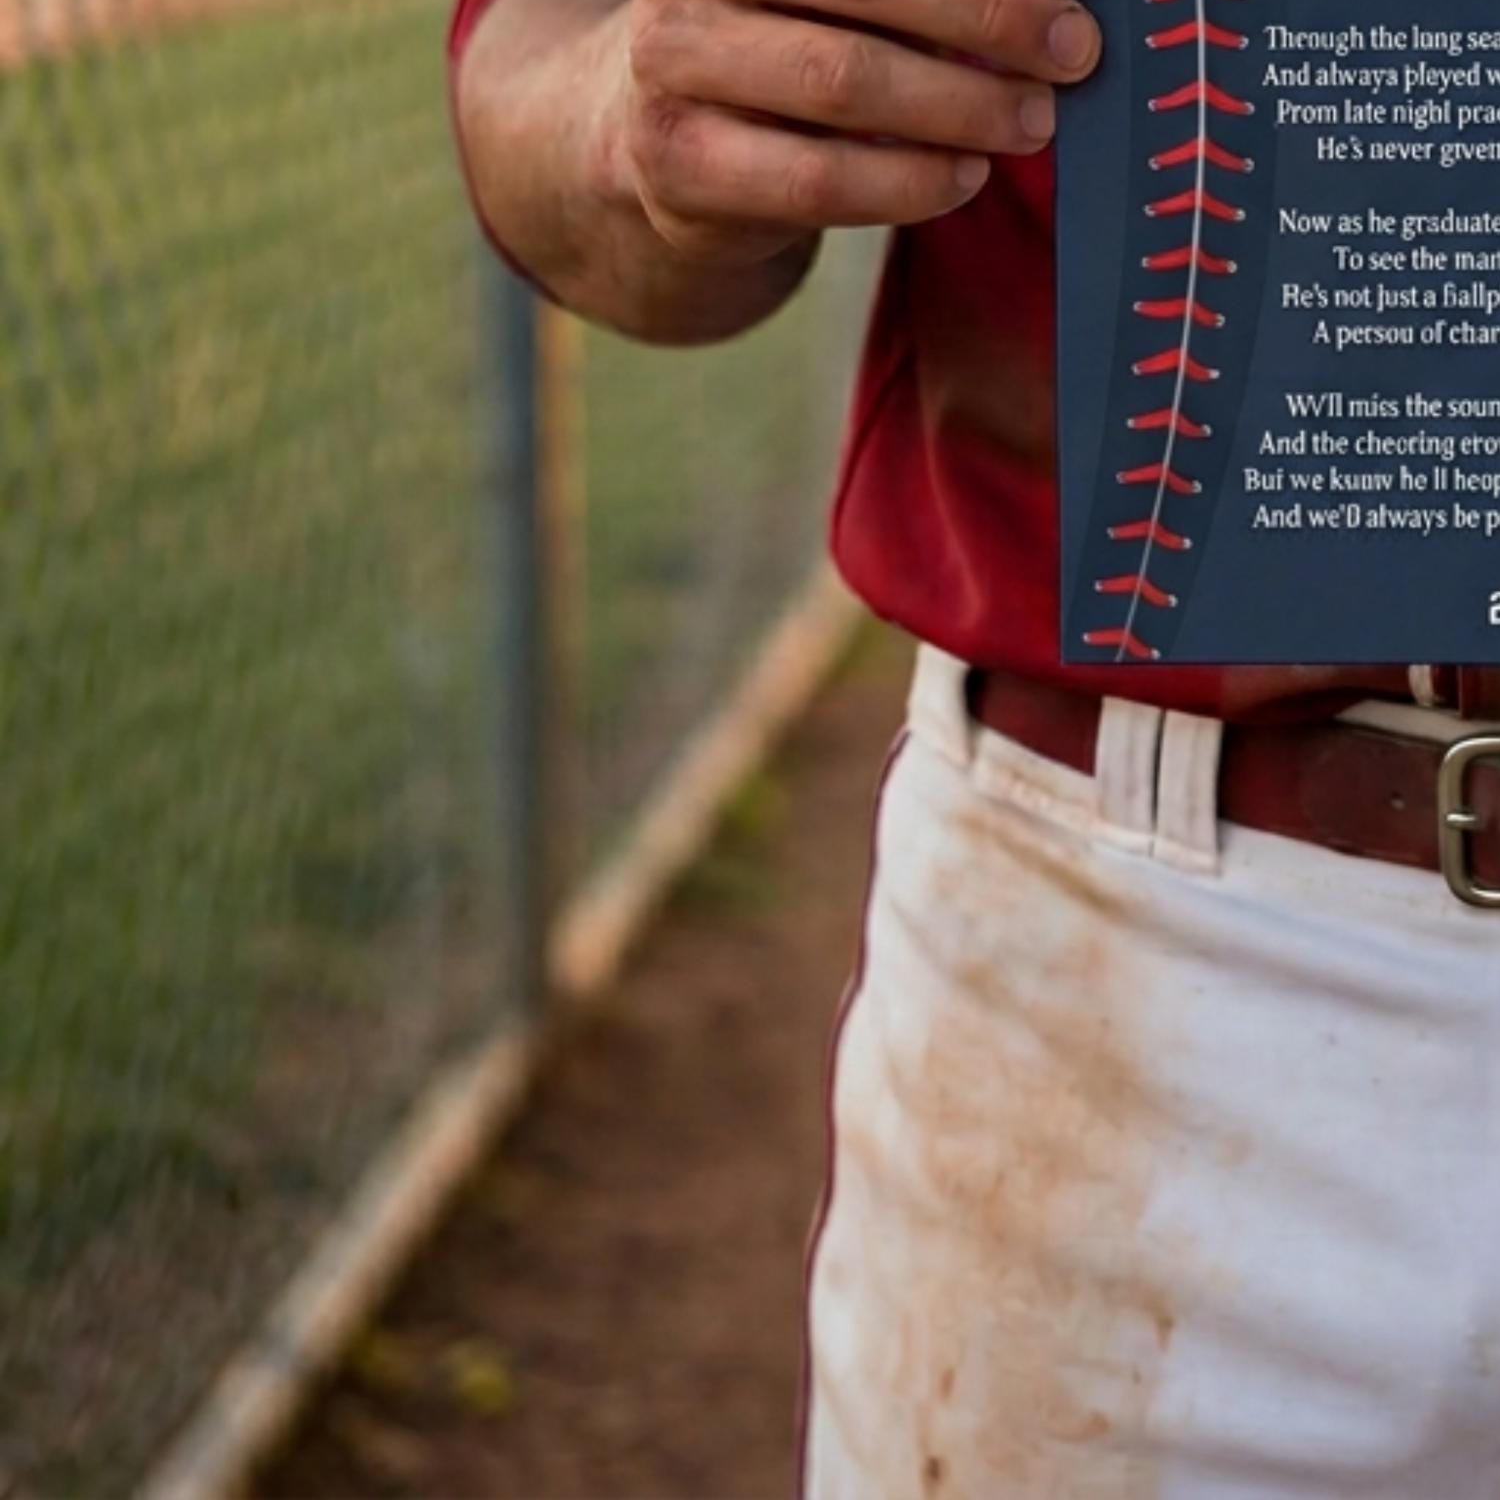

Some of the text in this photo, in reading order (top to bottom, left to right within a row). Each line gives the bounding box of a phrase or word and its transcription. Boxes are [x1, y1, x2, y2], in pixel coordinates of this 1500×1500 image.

[1261, 61, 1311, 87] And
[1343, 98, 1387, 124] late
[1316, 135, 1364, 161] He's
[1278, 207, 1333, 234] Now
[1337, 214, 1364, 235] as
[1367, 207, 1397, 235] he
[1332, 245, 1364, 271] To
[1367, 251, 1408, 271] see
[1410, 245, 1449, 271] the
[1333, 285, 1373, 308] not
[1422, 289, 1437, 309] a
[1312, 319, 1331, 344] A
[1419, 319, 1448, 344] of
[1404, 392, 1443, 418] the
[1258, 429, 1307, 455] And
[1288, 473, 1325, 492] we
[1251, 502, 1303, 529] And
[1452, 502, 1481, 529] be
